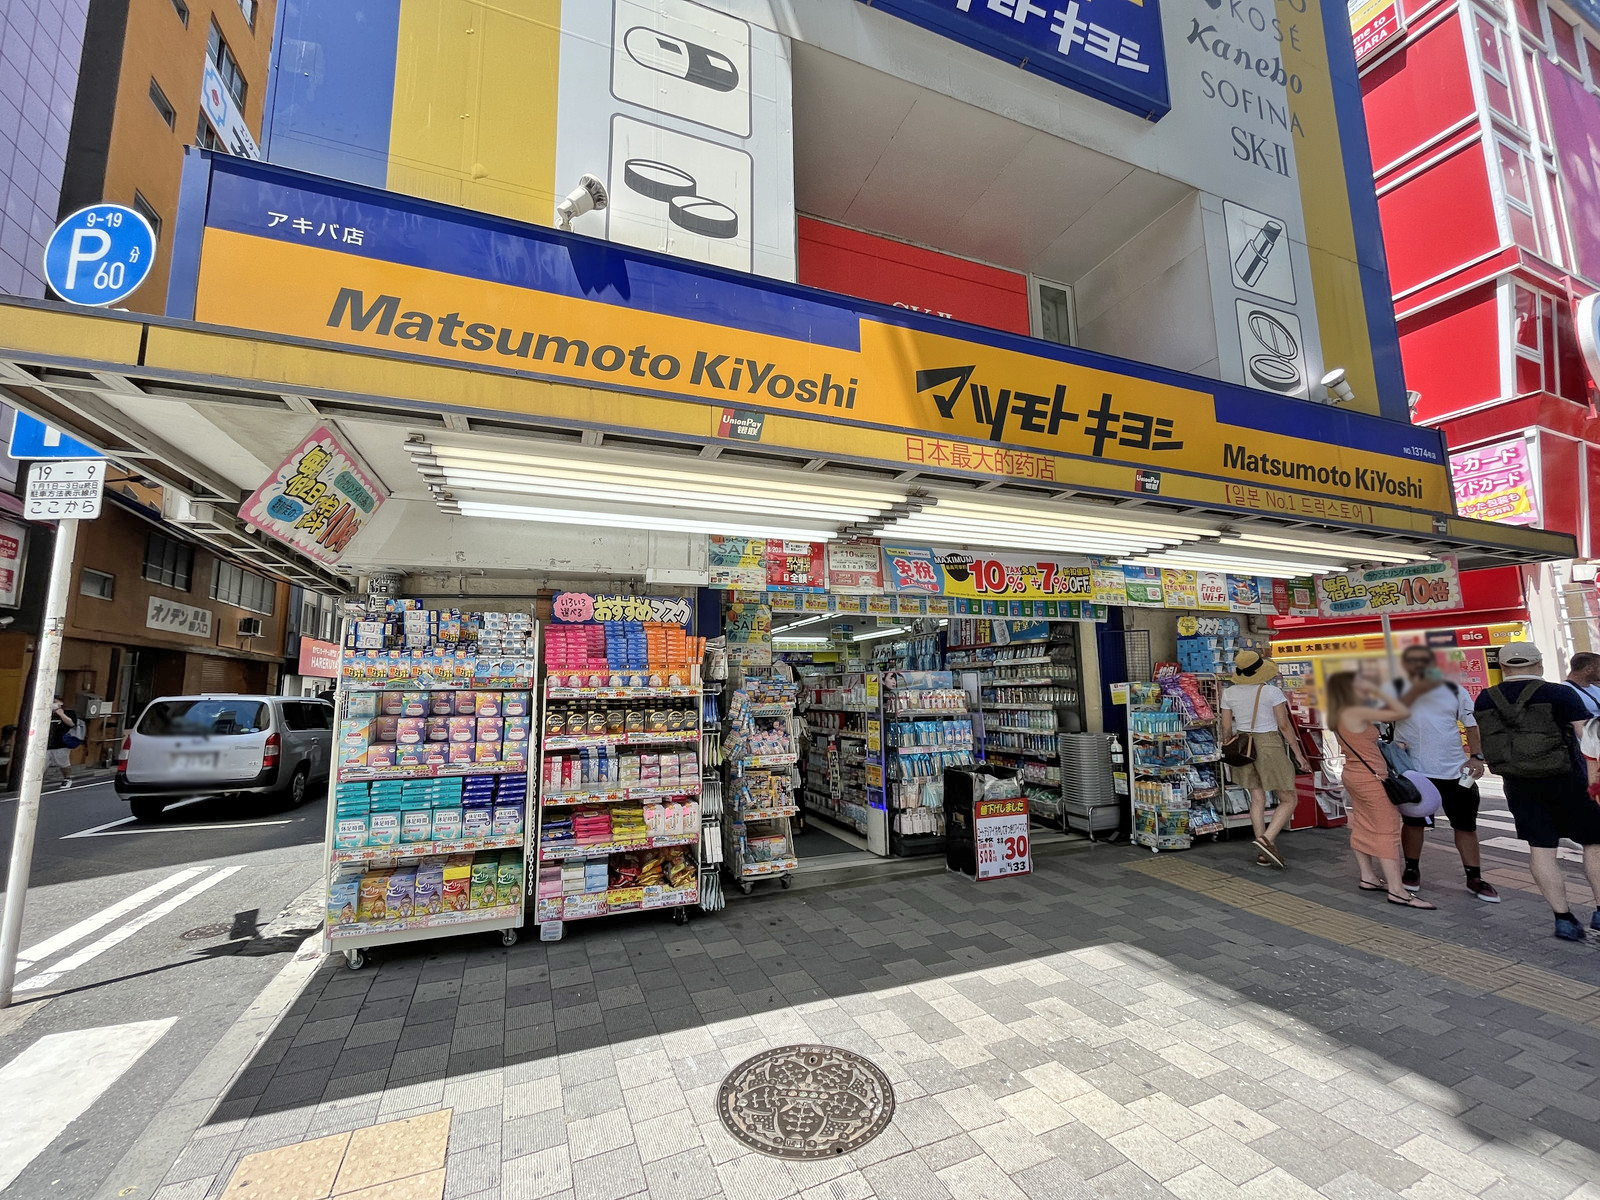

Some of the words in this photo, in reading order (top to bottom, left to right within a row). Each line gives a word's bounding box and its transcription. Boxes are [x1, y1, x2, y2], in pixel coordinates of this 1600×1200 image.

[1373, 16, 1386, 29] to
[1190, 17, 1302, 94] Kanebo
[1201, 70, 1305, 138] SOFINA
[87, 212, 122, 228] 9-19
[267, 211, 365, 246] アキバ店
[65, 228, 111, 290] P
[94, 261, 125, 290] 60
[129, 246, 140, 263] 分
[326, 287, 680, 381] Matsumoto
[689, 350, 858, 410] KiYoshi
[915, 364, 1184, 457] マツモトキヨシ
[721, 414, 762, 437] UnionPay
[905, 436, 1055, 481] 日本最大的药店
[38, 466, 52, 480] 19
[87, 465, 96, 479] 9
[1223, 443, 1351, 488] Matsumoto
[1355, 467, 1423, 499] KiYoshi
[30, 500, 95, 514] ここから
[1265, 491, 1296, 512] No.1
[1300, 498, 1365, 523] 드럭스토어
[718, 543, 761, 556] SALE
[933, 555, 974, 564] MAXIMUM
[1005, 565, 1021, 574] TAX
[1201, 584, 1222, 593] Free
[1202, 592, 1226, 602] Wi-Fi
[1401, 576, 1450, 606] 10倍
[561, 598, 586, 606] いろいろ
[561, 607, 583, 617] 選べる
[151, 604, 189, 626] オノデン
[733, 621, 764, 631] SALE
[1005, 835, 1027, 860] 30
